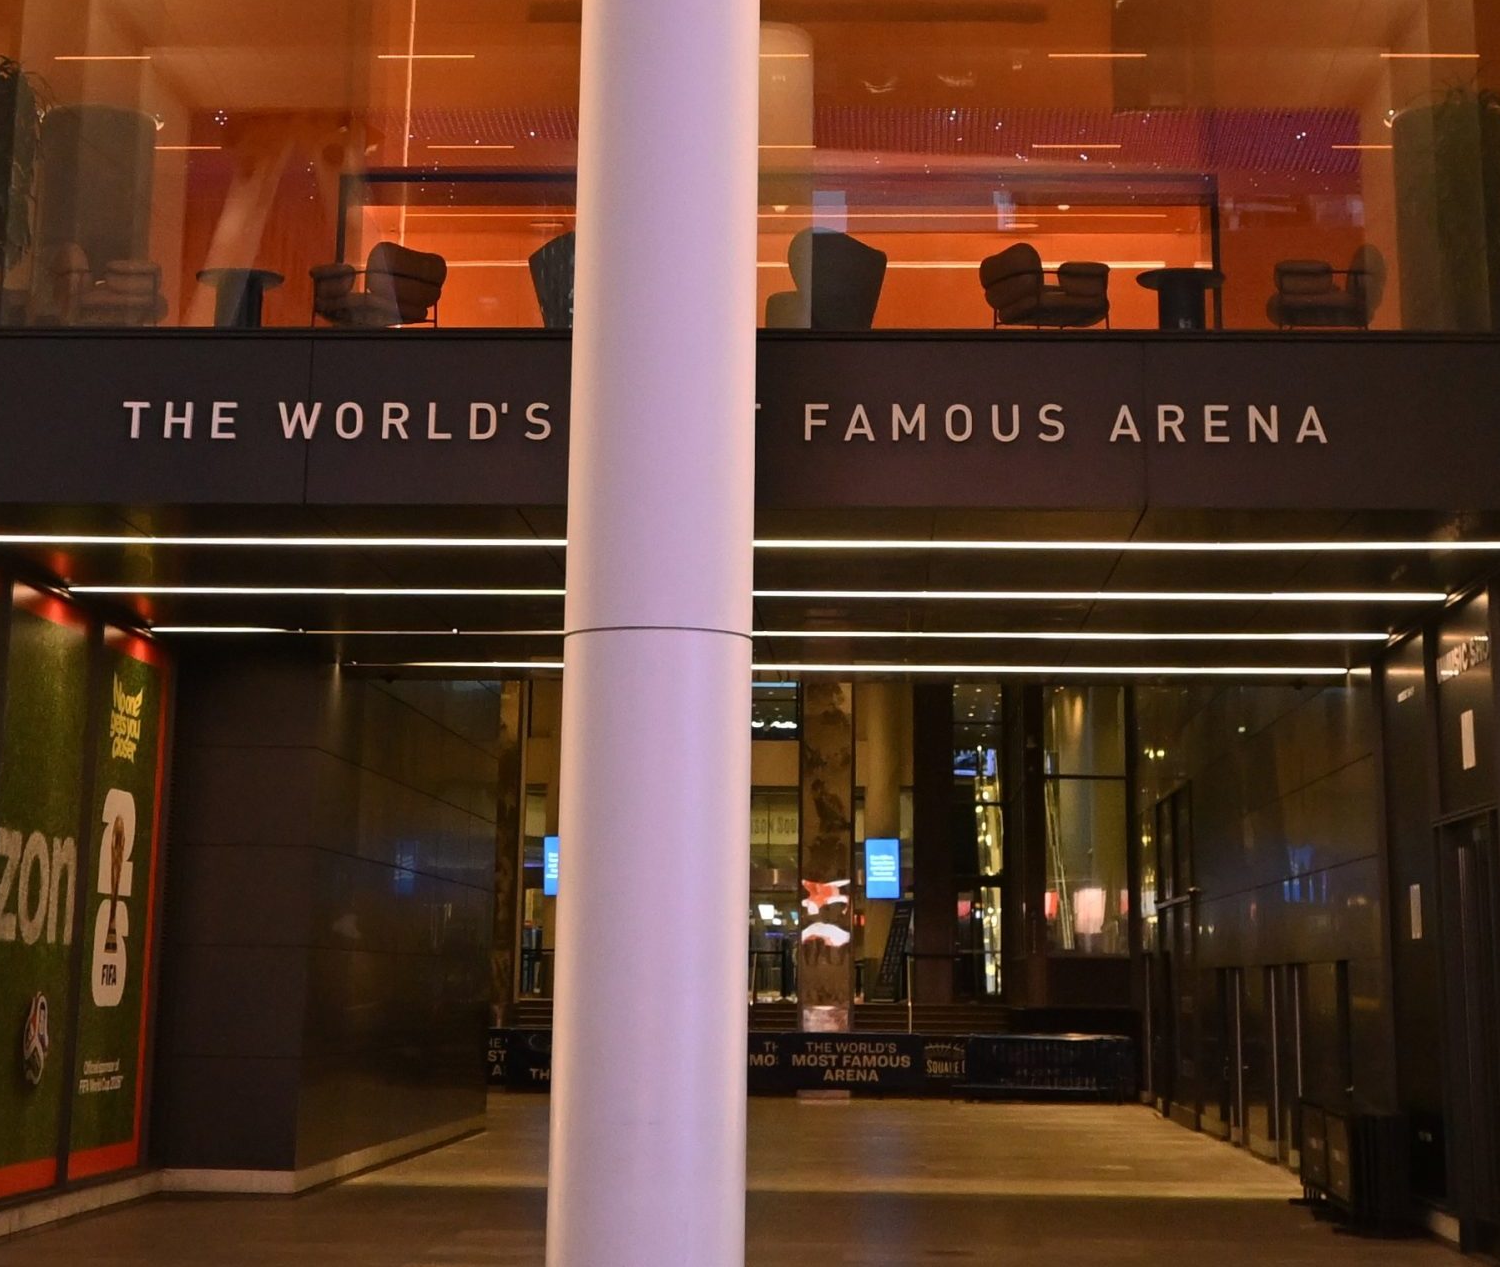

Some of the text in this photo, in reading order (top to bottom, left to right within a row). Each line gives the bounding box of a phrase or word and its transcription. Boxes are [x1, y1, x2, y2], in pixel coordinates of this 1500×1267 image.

[122, 400, 1329, 444] THE WORLD'S FAMOUS ARENA
[101, 963, 118, 987] FIFA
[806, 1041, 897, 1054] THE WORLD'S
[791, 1054, 911, 1068] MOST FAMOUS
[823, 1068, 879, 1082] ARENA
